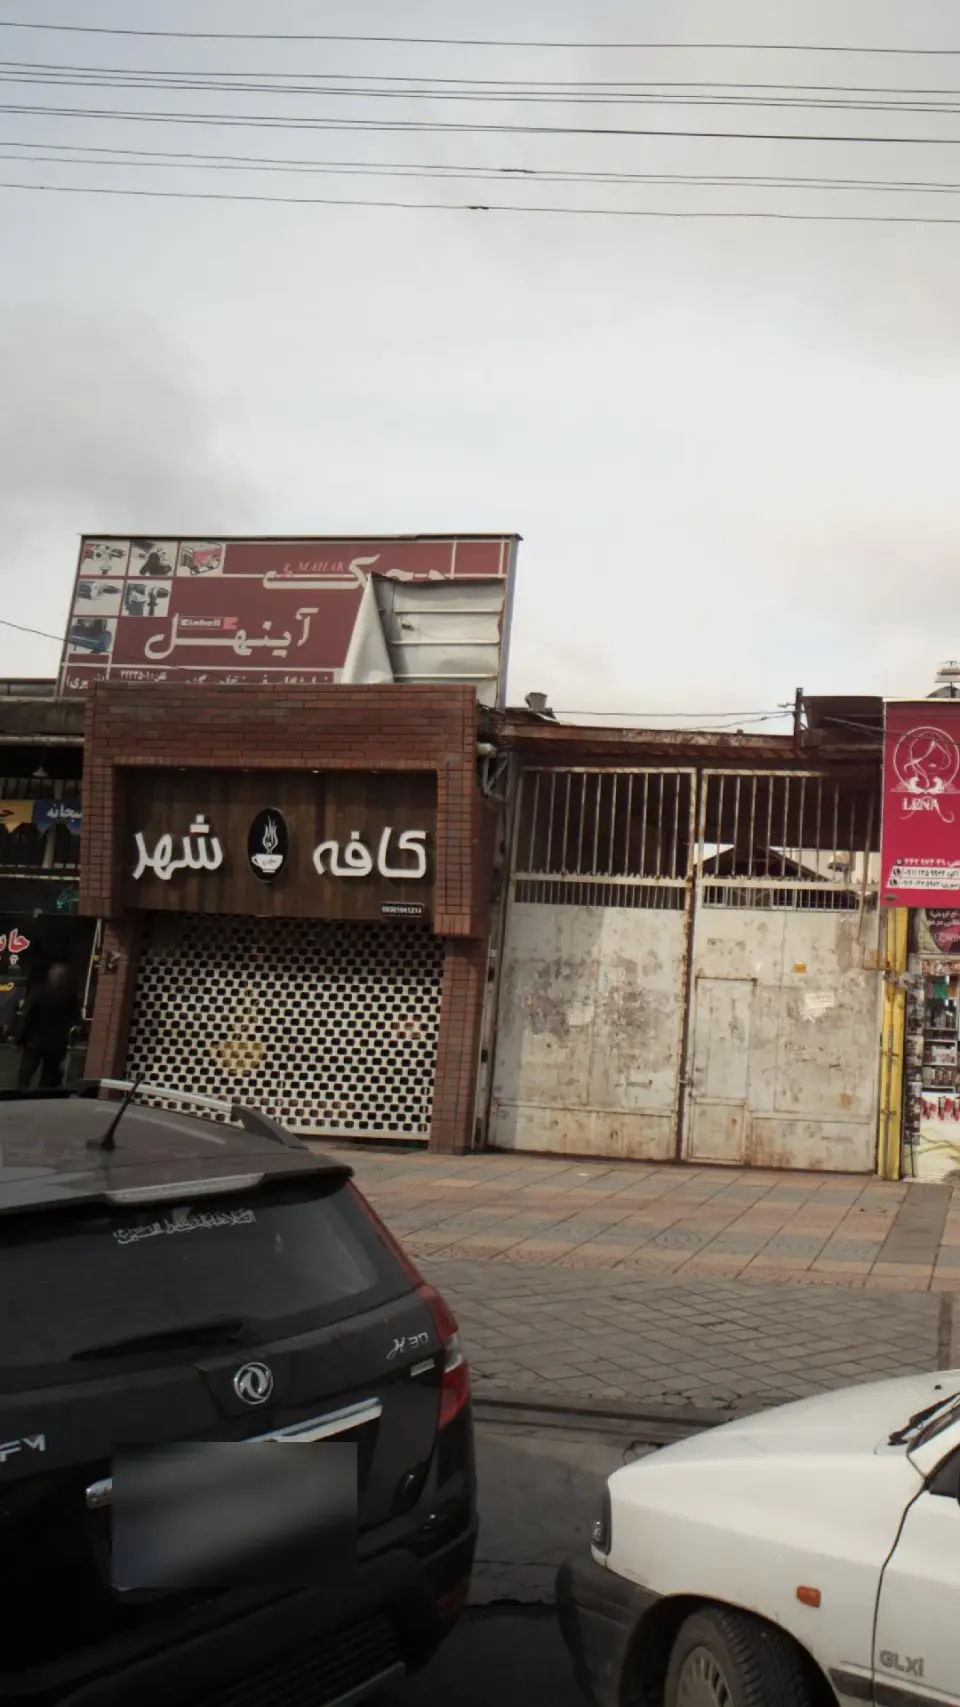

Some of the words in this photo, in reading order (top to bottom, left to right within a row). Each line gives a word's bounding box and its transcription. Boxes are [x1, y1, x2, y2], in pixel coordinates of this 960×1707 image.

[180, 618, 221, 627] Einhell
[132, 813, 224, 881] شهر
[312, 826, 428, 879] کافه
